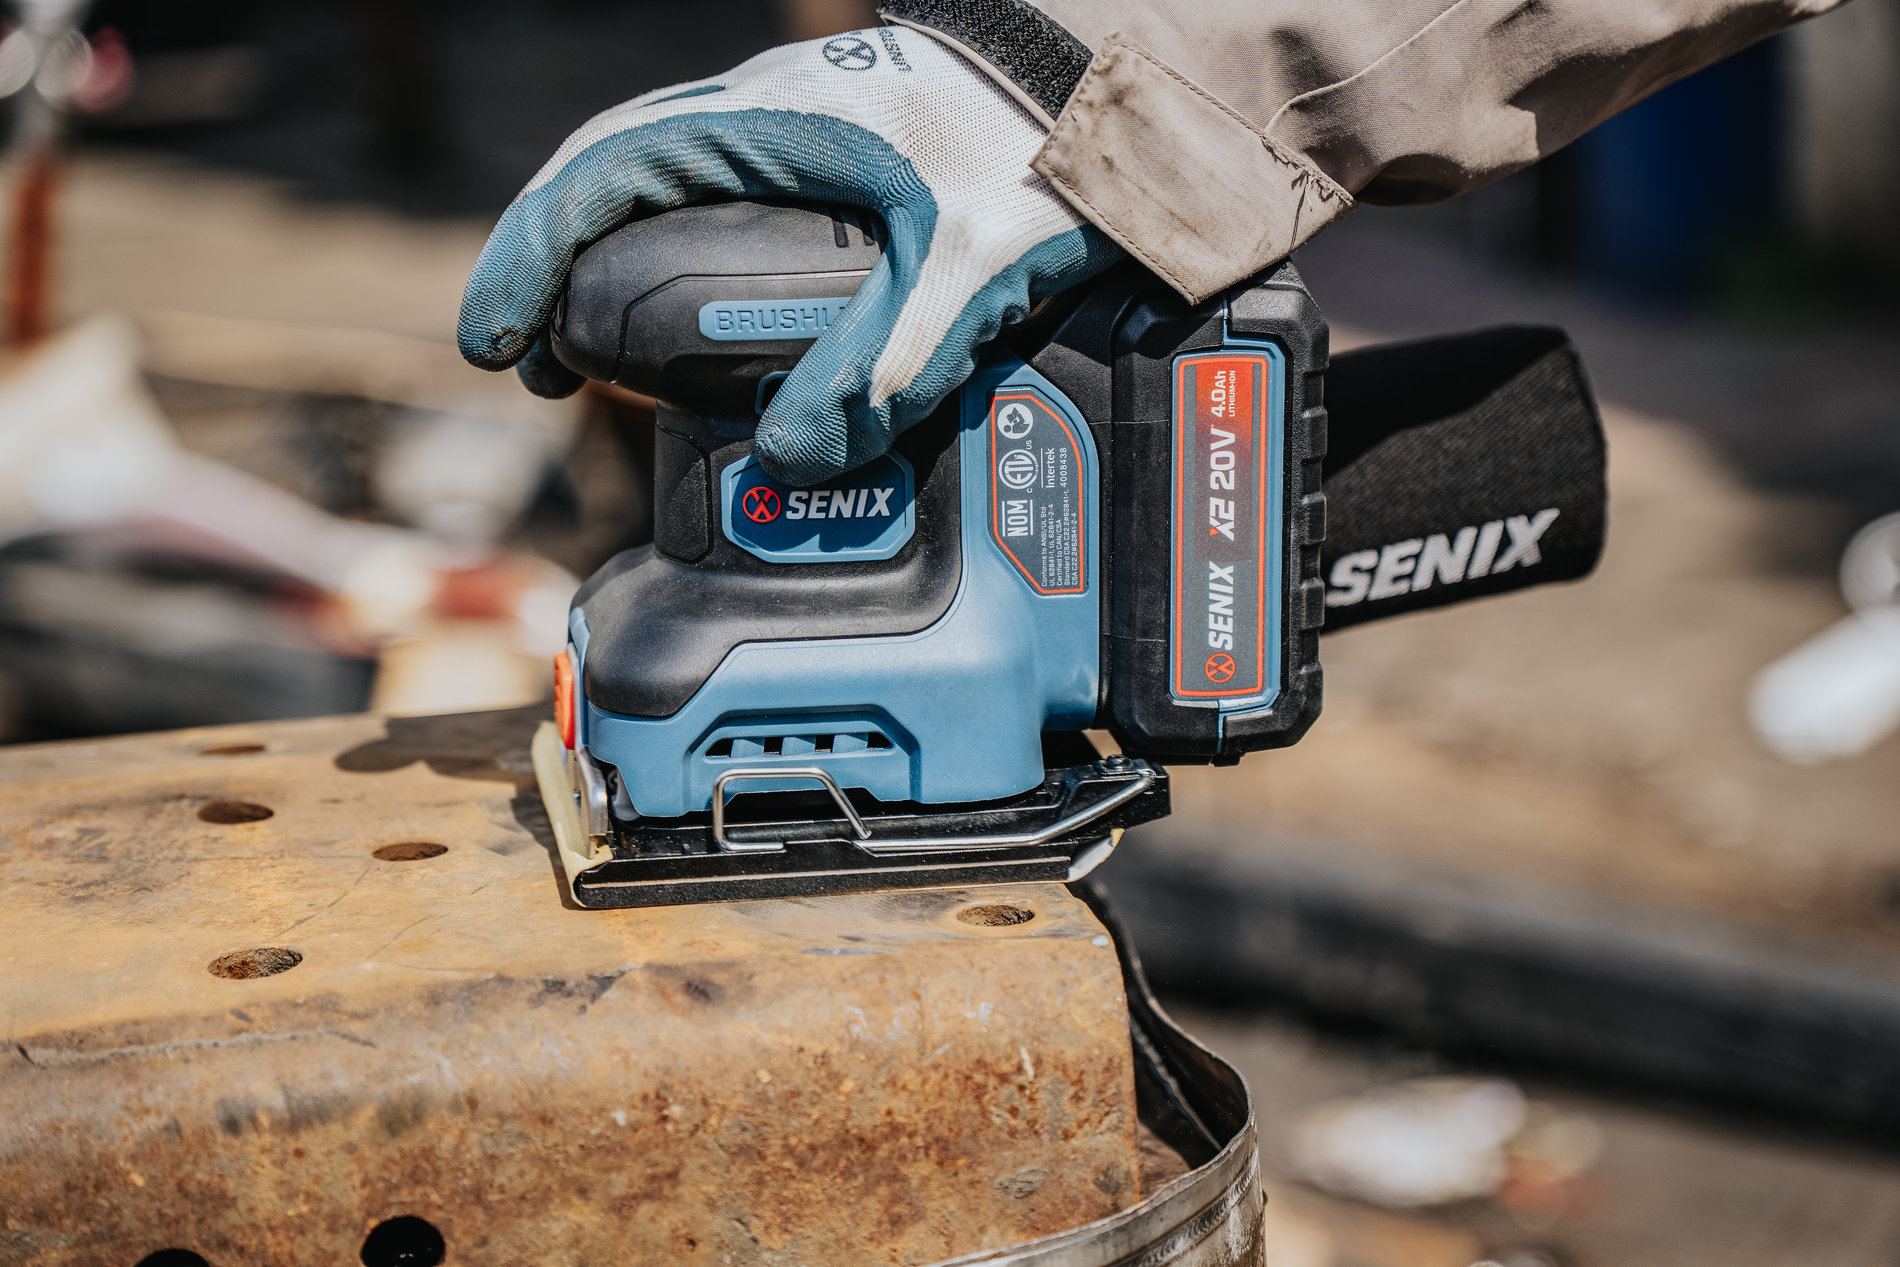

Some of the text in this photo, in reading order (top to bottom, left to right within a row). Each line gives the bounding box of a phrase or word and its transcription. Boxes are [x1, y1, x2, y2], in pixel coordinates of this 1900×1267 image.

[1211, 370, 1227, 417] 4.0Ah
[1026, 440, 1032, 449] US
[1004, 455, 1033, 484] ETL
[1046, 448, 1055, 488] Intertek
[786, 487, 895, 521] SENIX
[1006, 500, 1028, 536] NOM
[1049, 540, 1054, 548] UL
[1325, 507, 1561, 609] SENIX
[1049, 578, 1055, 586] UL
[1208, 561, 1234, 650] SENIX
